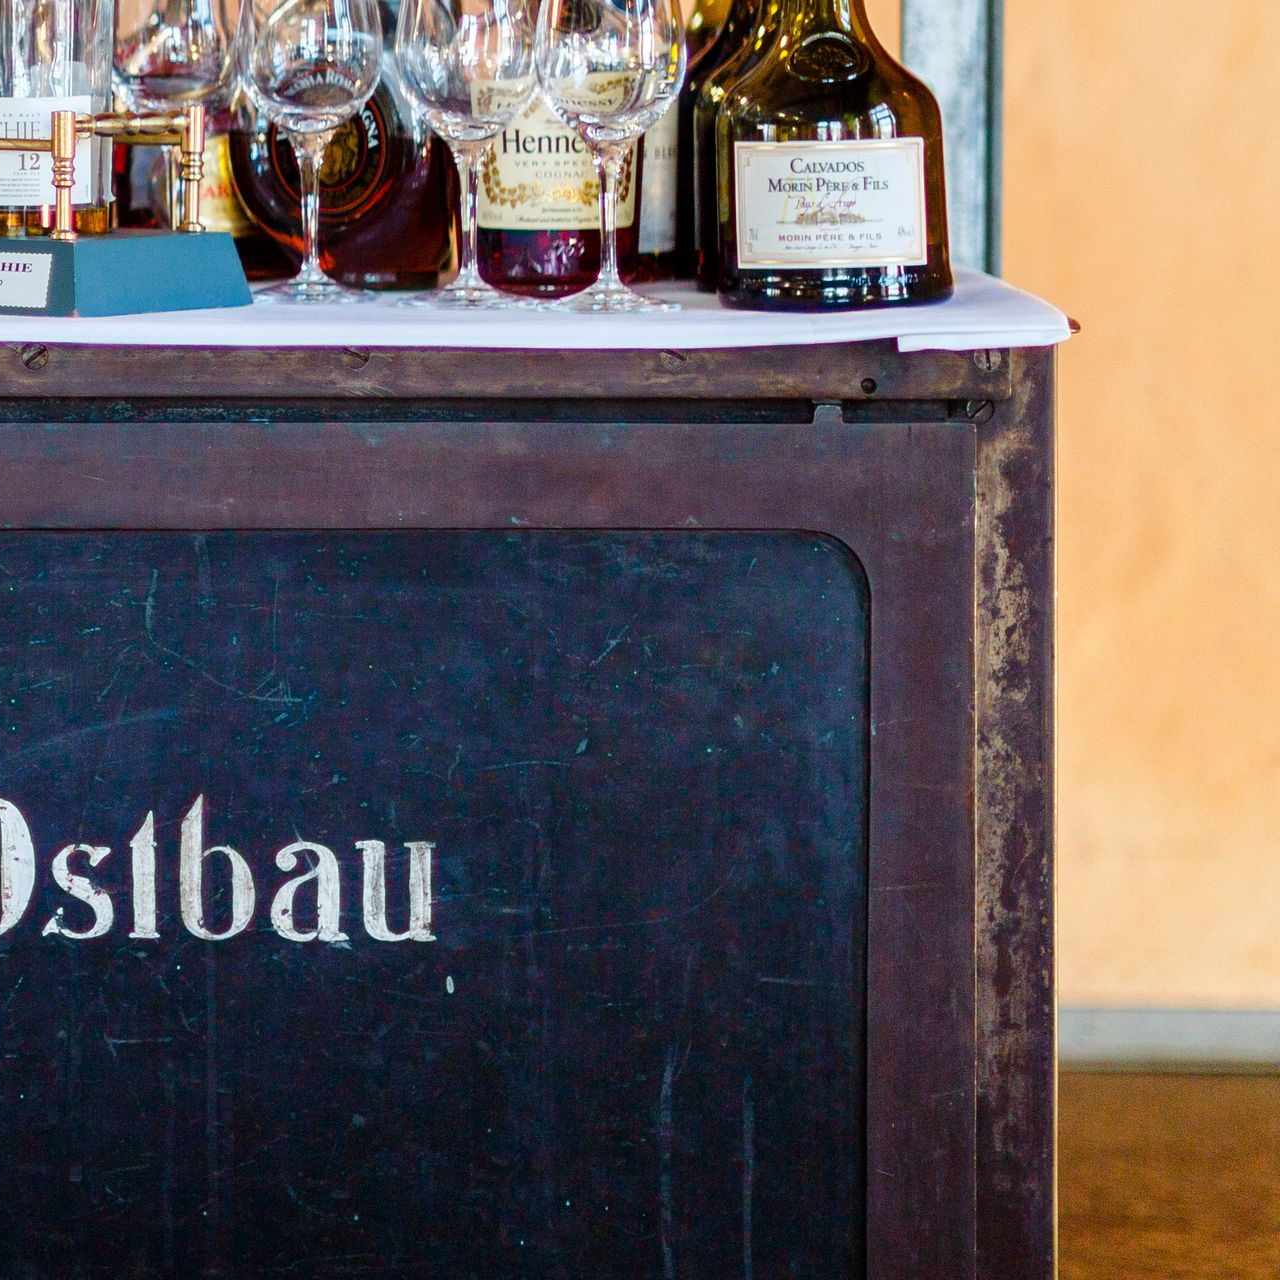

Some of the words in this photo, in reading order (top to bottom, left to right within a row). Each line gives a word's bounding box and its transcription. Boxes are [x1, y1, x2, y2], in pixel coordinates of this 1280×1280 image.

[502, 128, 587, 154] Henne
[18, 153, 41, 171] 12
[790, 158, 865, 174] CALVADOS
[768, 178, 812, 193] MORIN
[816, 177, 849, 192] PÈRE
[851, 183, 858, 191] &
[862, 176, 889, 190] FILS
[816, 231, 844, 241] PÈRE
